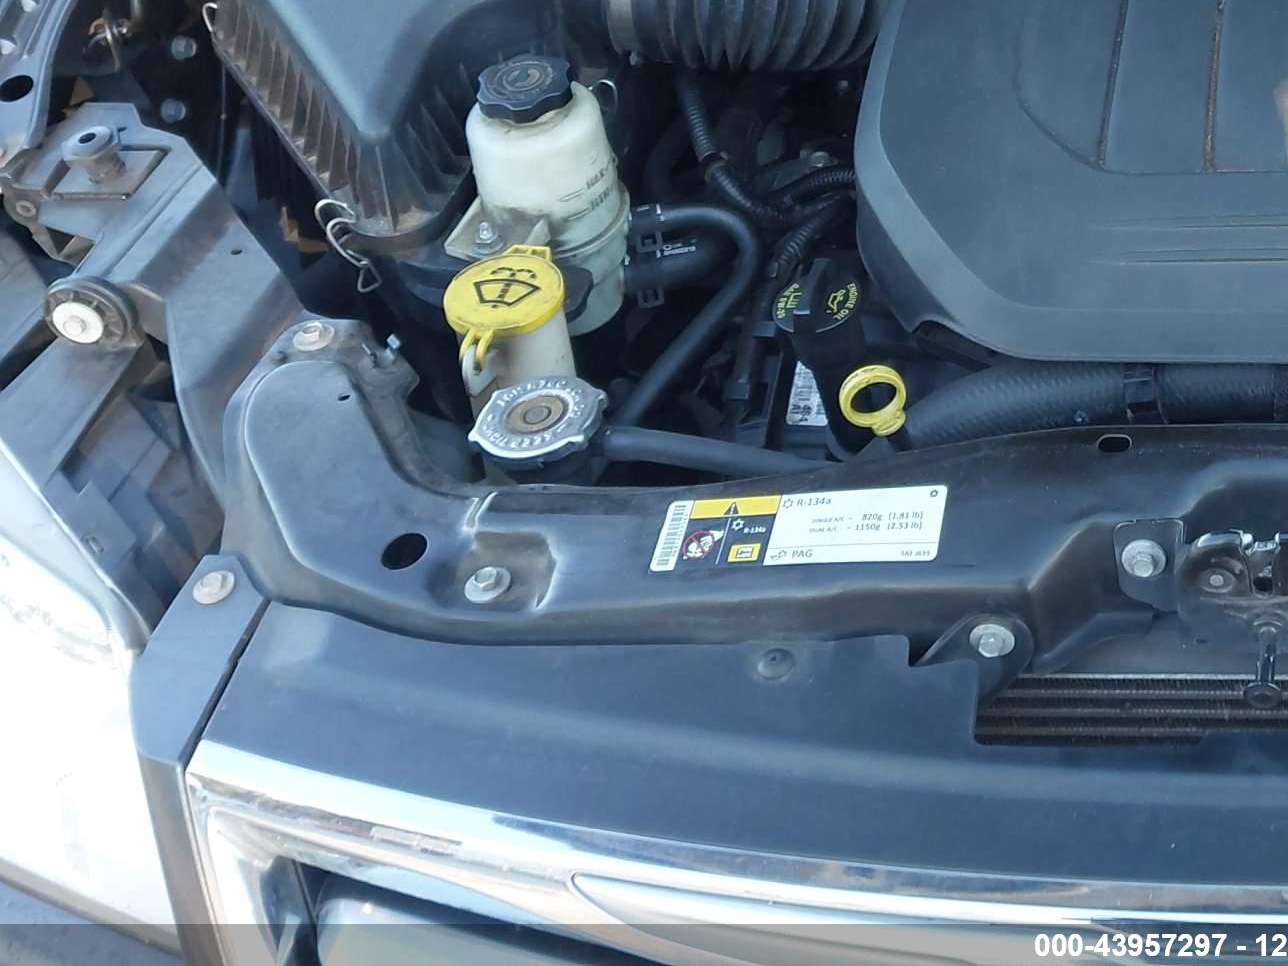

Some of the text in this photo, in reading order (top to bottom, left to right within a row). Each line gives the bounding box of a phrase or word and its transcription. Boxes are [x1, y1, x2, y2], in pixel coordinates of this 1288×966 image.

[796, 497, 832, 507] R-134a
[855, 522, 880, 532] 1150g
[791, 549, 813, 559] PAG
